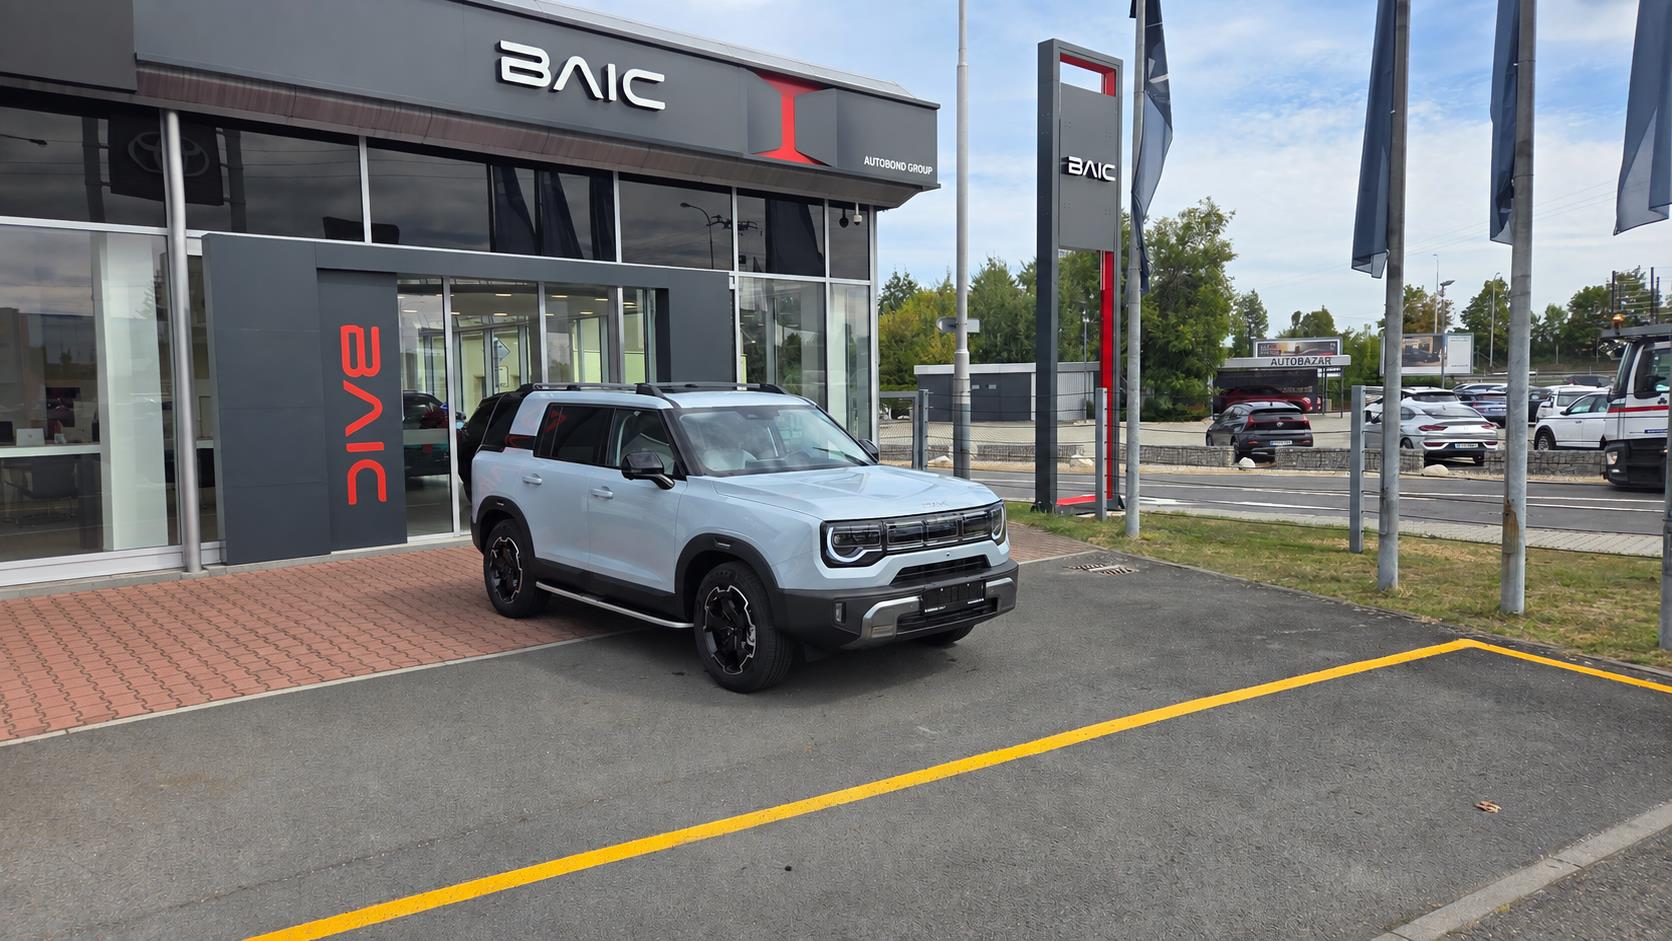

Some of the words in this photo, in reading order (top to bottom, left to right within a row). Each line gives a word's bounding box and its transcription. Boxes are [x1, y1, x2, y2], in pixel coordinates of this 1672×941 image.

[498, 40, 666, 110] BAIC
[864, 155, 907, 171] AUTOBOND
[907, 163, 933, 175] GROUP
[1068, 155, 1116, 182] BAIC
[1270, 356, 1332, 366] AUTOBAZAR
[340, 325, 387, 505] BAIC
